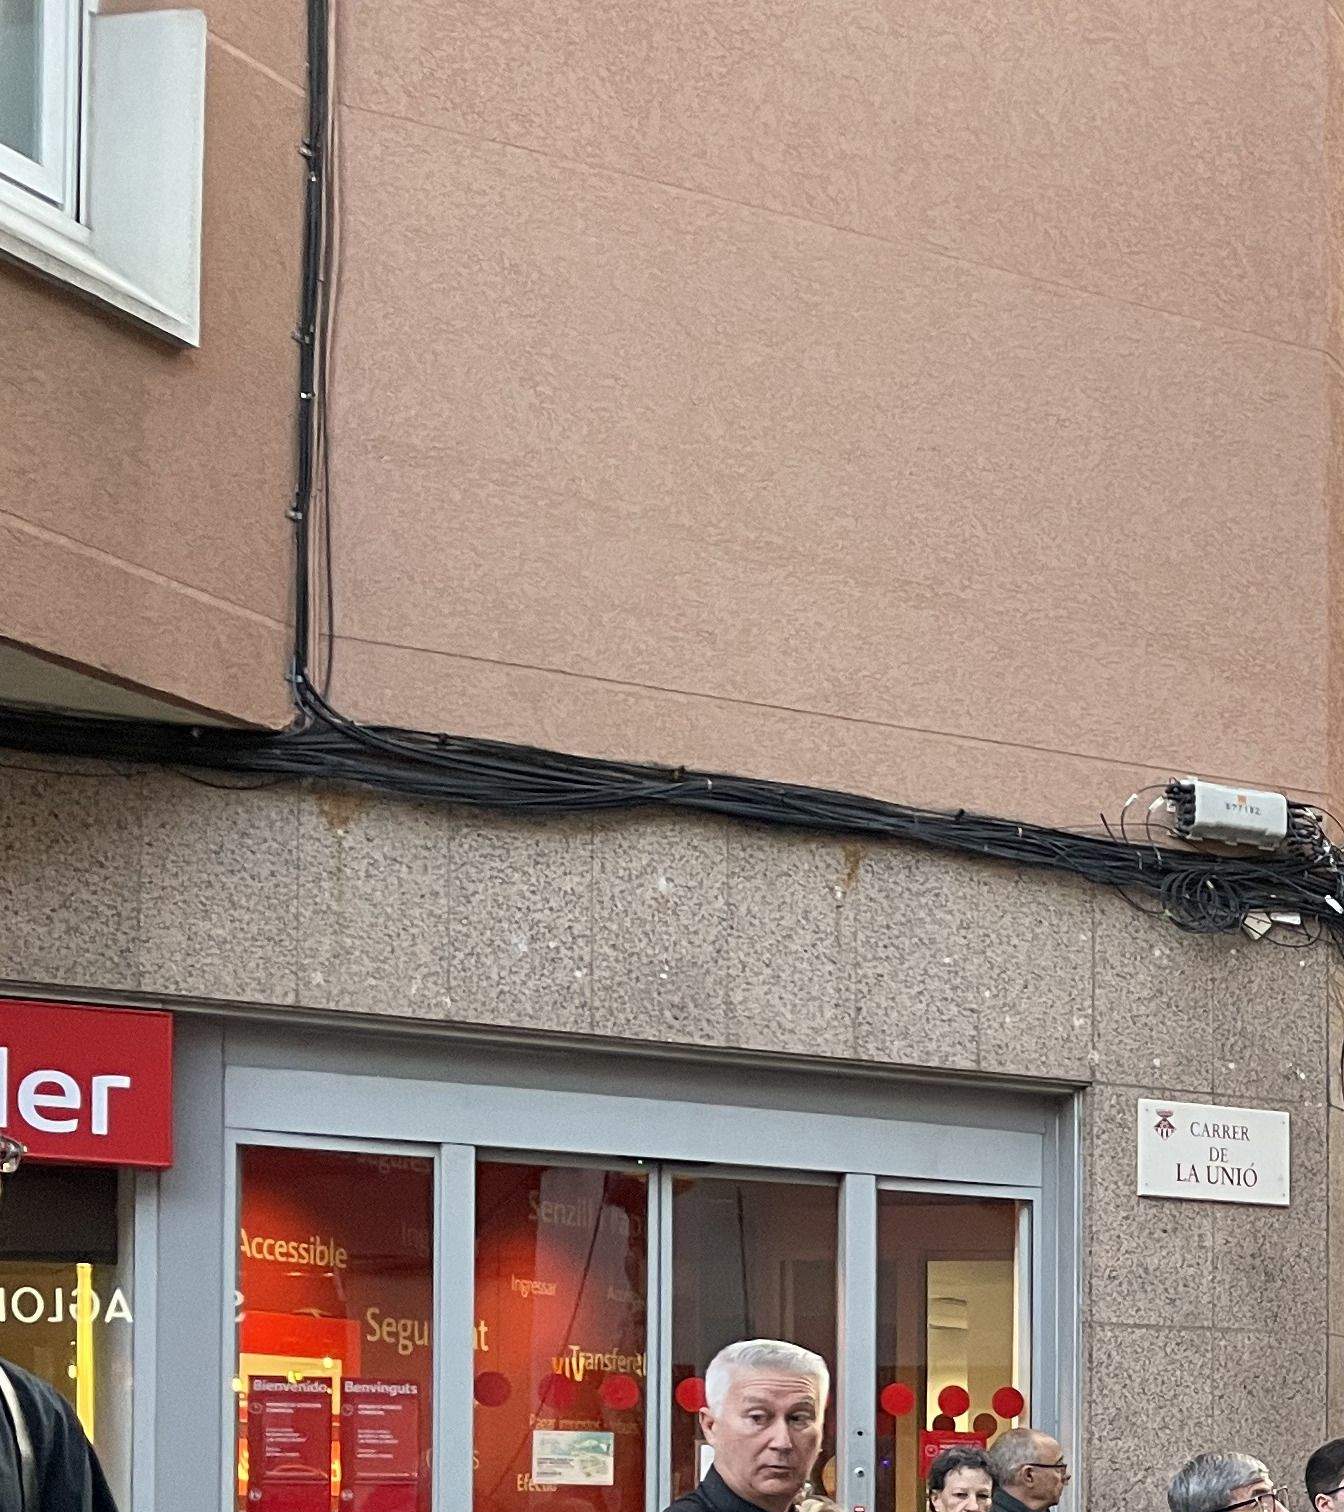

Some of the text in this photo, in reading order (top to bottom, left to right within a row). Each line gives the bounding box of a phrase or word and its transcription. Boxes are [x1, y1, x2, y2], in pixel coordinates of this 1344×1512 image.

[1190, 1121, 1250, 1142] CARRER
[1209, 1147, 1229, 1163] DE
[1176, 1162, 1258, 1188] LA UNIÓ
